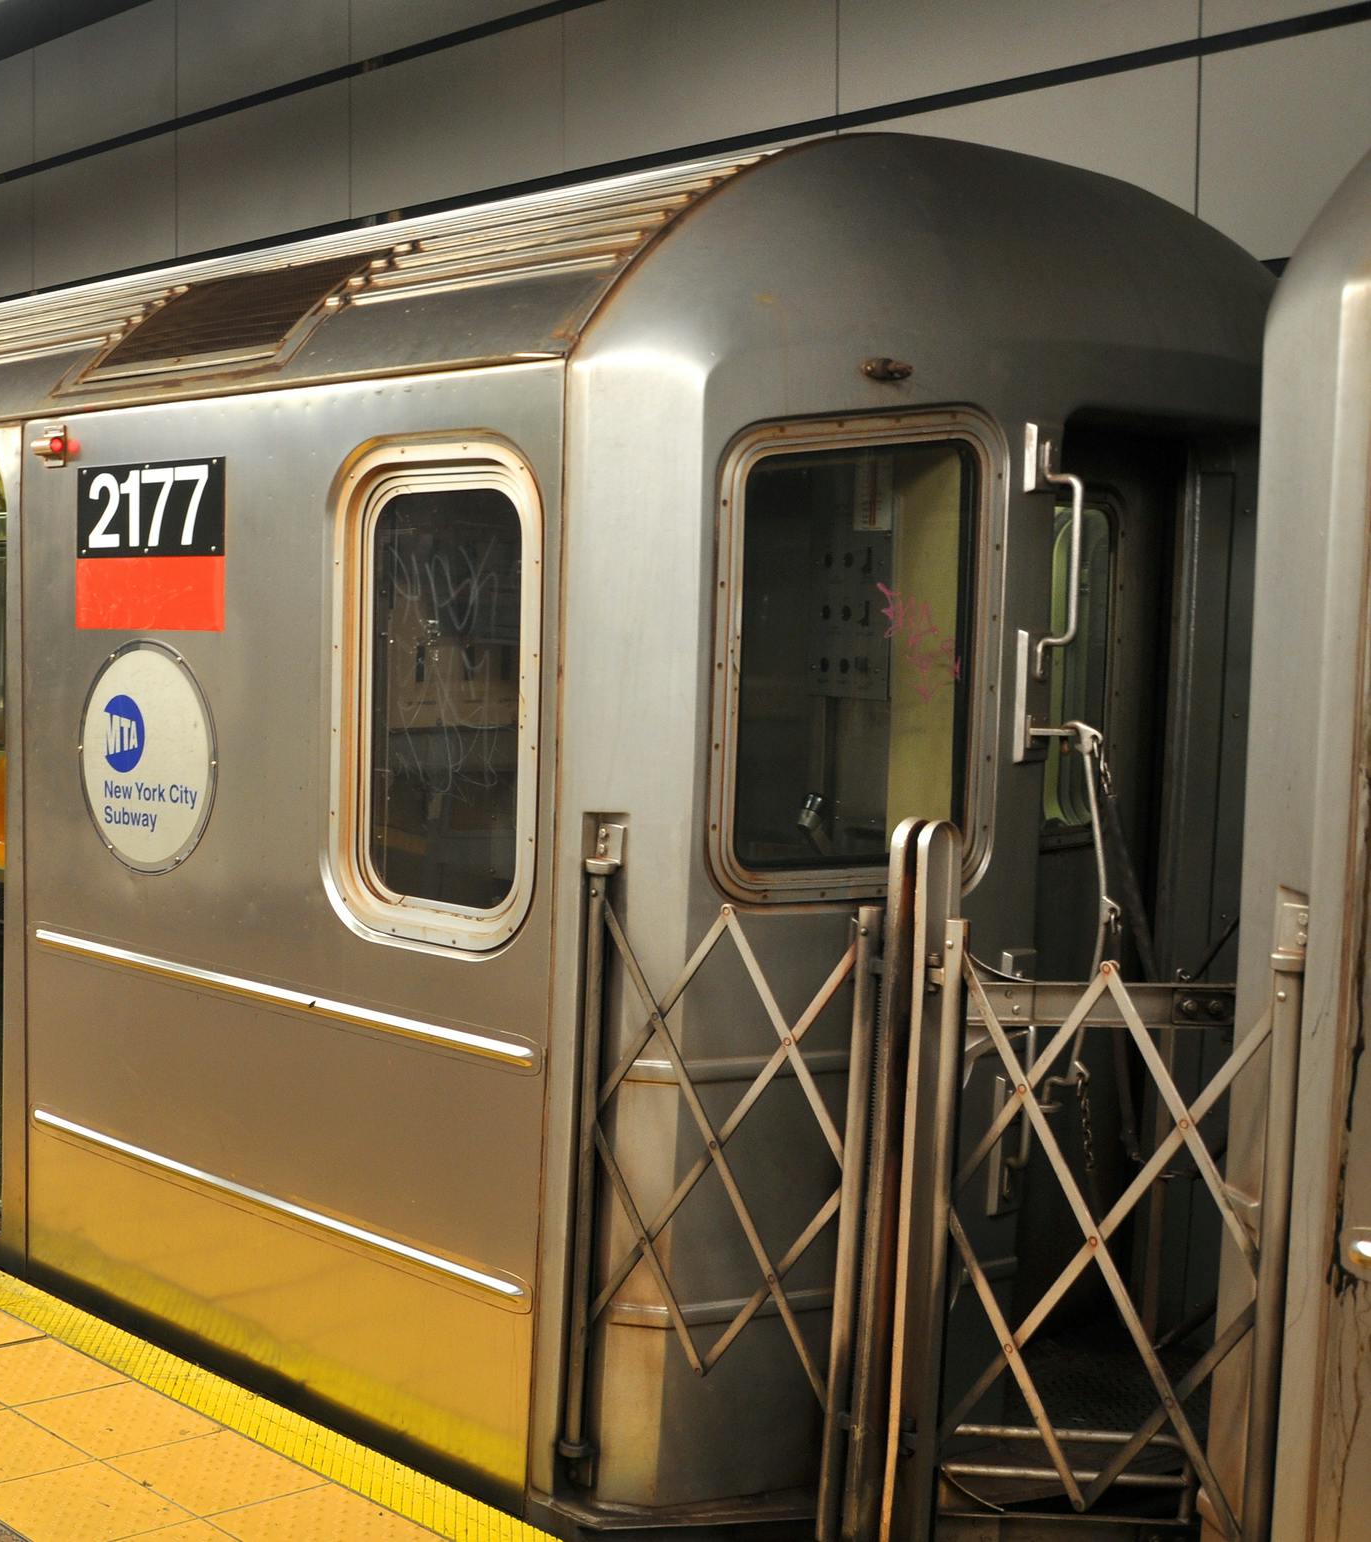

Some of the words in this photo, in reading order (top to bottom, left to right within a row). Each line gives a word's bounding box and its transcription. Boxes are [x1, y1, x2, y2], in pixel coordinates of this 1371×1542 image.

[88, 464, 209, 549] 2177
[104, 713, 138, 756] MTA
[104, 780, 133, 800] New
[135, 782, 166, 803] York
[169, 784, 198, 810] City
[104, 805, 158, 833] Subway
